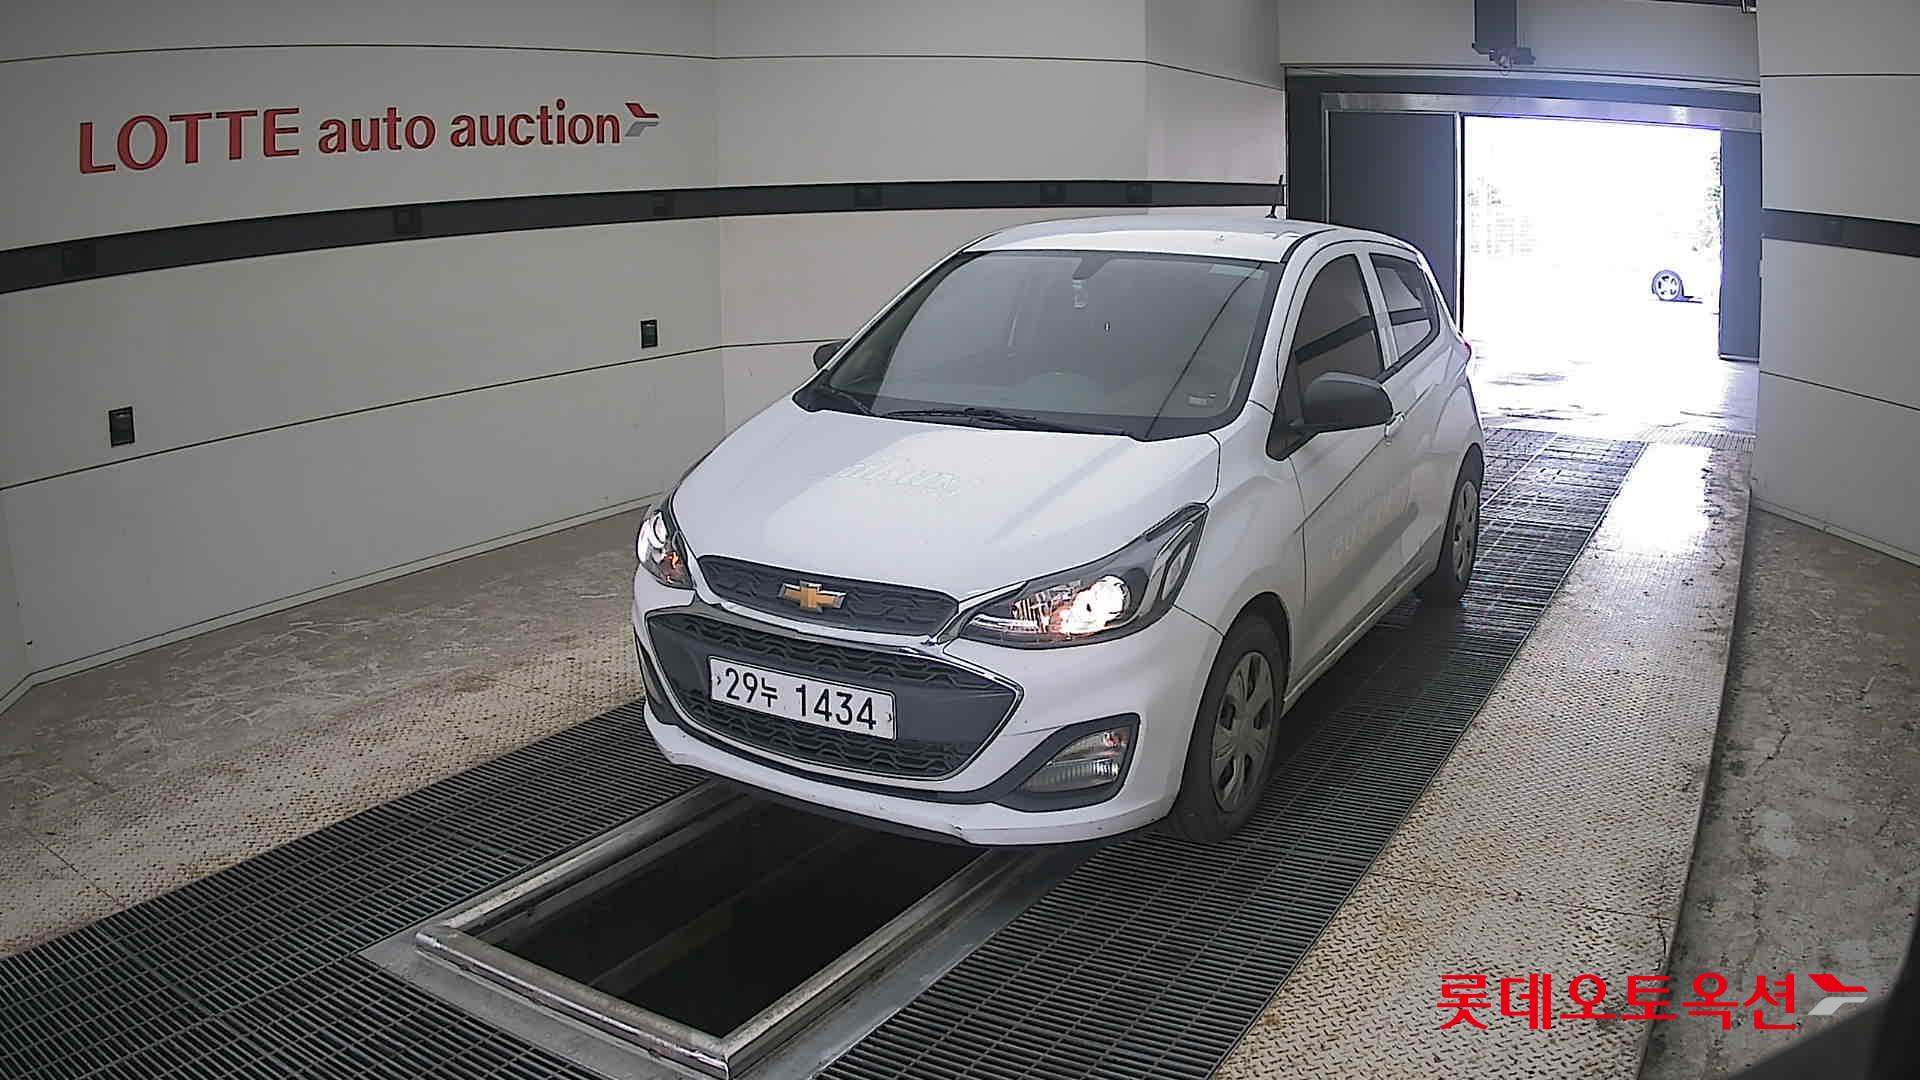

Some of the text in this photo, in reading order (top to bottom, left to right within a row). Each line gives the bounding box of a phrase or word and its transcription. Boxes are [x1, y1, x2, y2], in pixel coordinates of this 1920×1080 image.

[79, 98, 621, 174] LOTTE auto auction
[725, 667, 877, 730] 29누 1434
